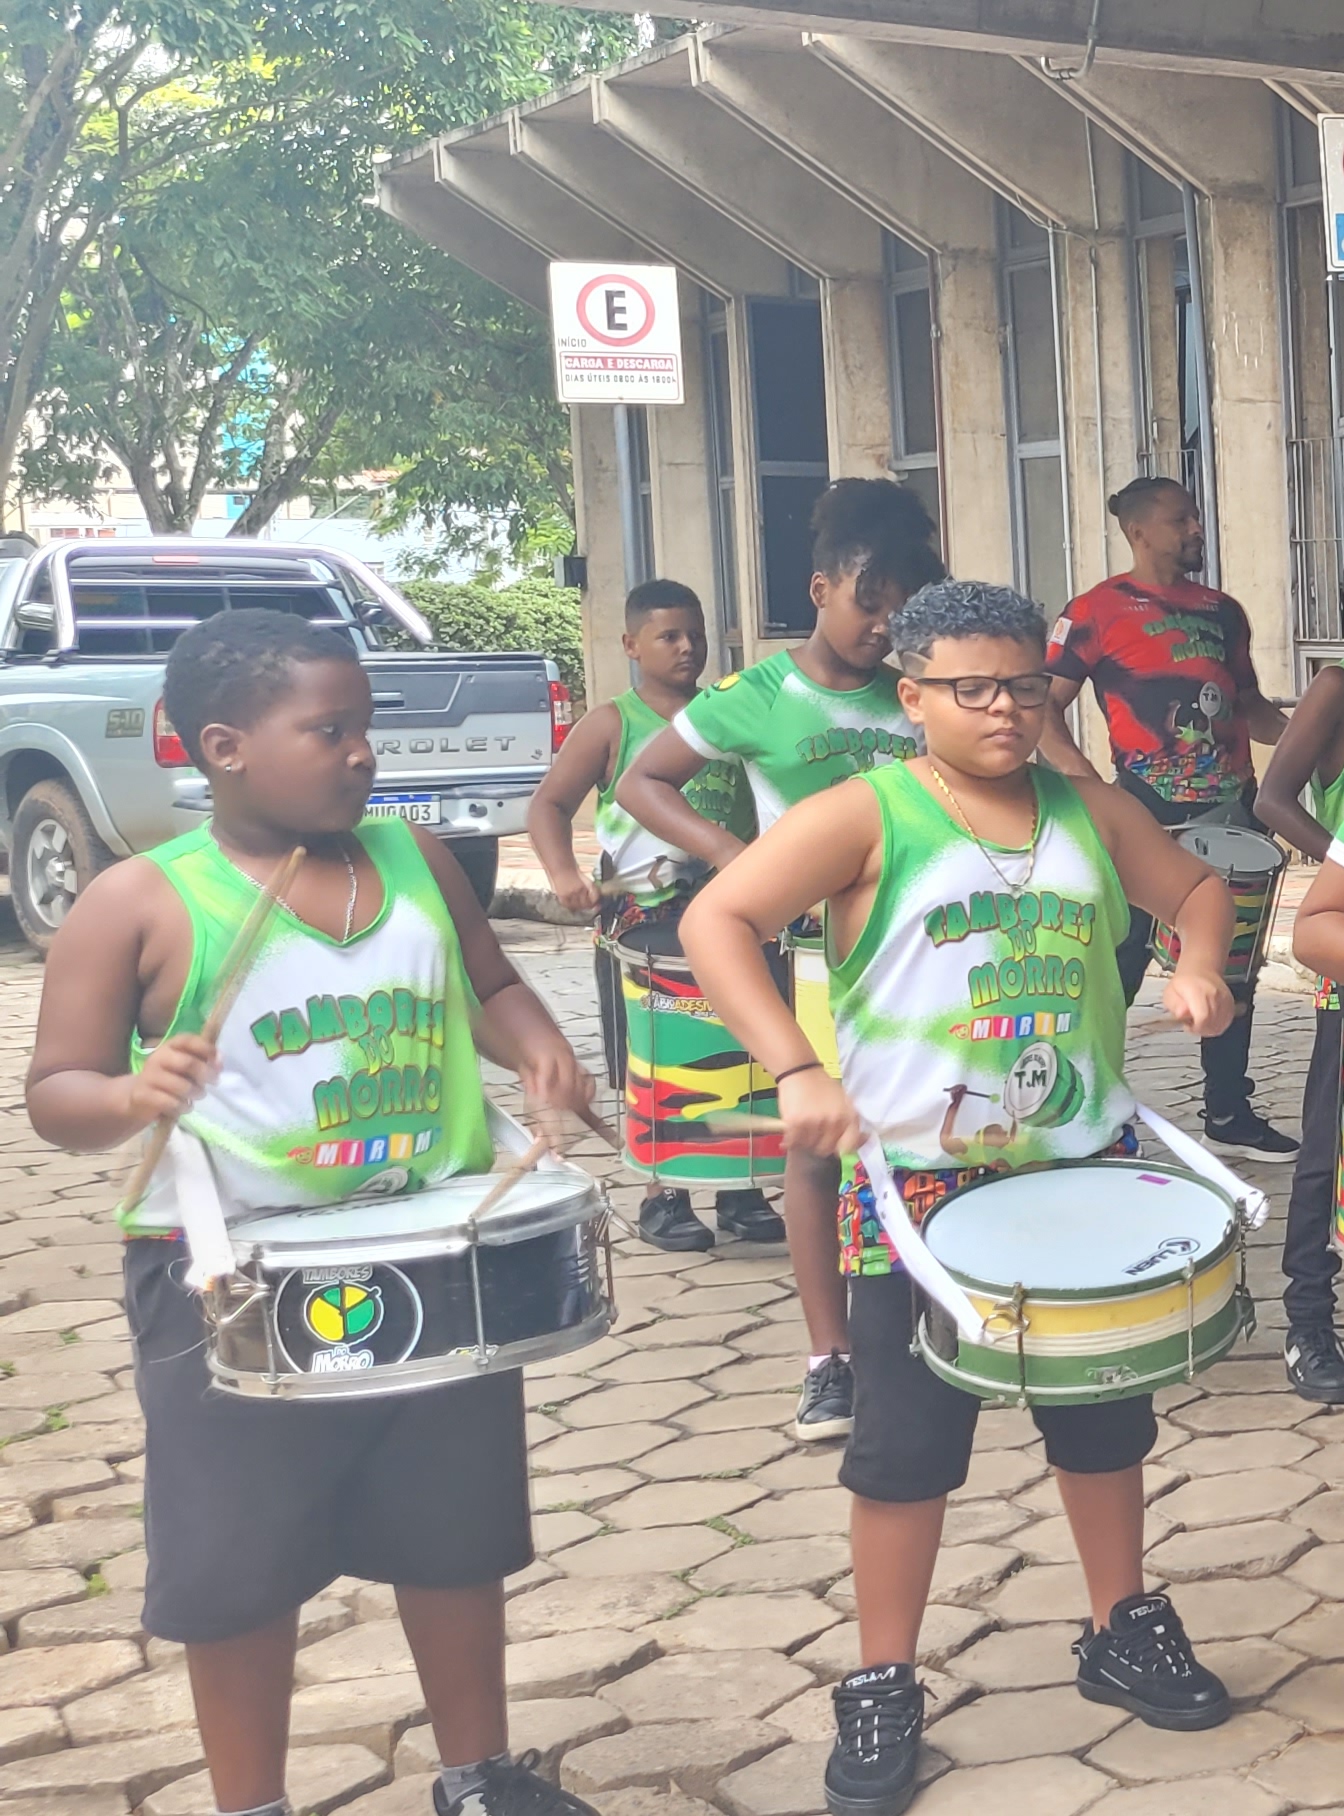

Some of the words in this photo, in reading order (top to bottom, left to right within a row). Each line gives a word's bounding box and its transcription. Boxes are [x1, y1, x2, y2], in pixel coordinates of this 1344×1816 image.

[604, 289, 628, 331] E
[558, 336, 587, 348] INÍCIO
[565, 357, 604, 369] CARGA
[607, 357, 615, 369] E
[616, 358, 673, 370] DESCARGA
[565, 374, 585, 383] DIAS
[587, 373, 611, 383] ÚTEIS
[376, 736, 516, 756] ROLET
[923, 890, 1096, 949] TAMBORES
[1006, 919, 1037, 962] DO
[967, 955, 1086, 1009] MORRO
[971, 1012, 1072, 1041] MIRIM
[358, 1025, 396, 1076] DO
[312, 1063, 442, 1131] MORRO
[313, 1128, 433, 1168] MIRIM
[304, 1264, 370, 1281] TAMBORES
[314, 1352, 371, 1373] MORRO
